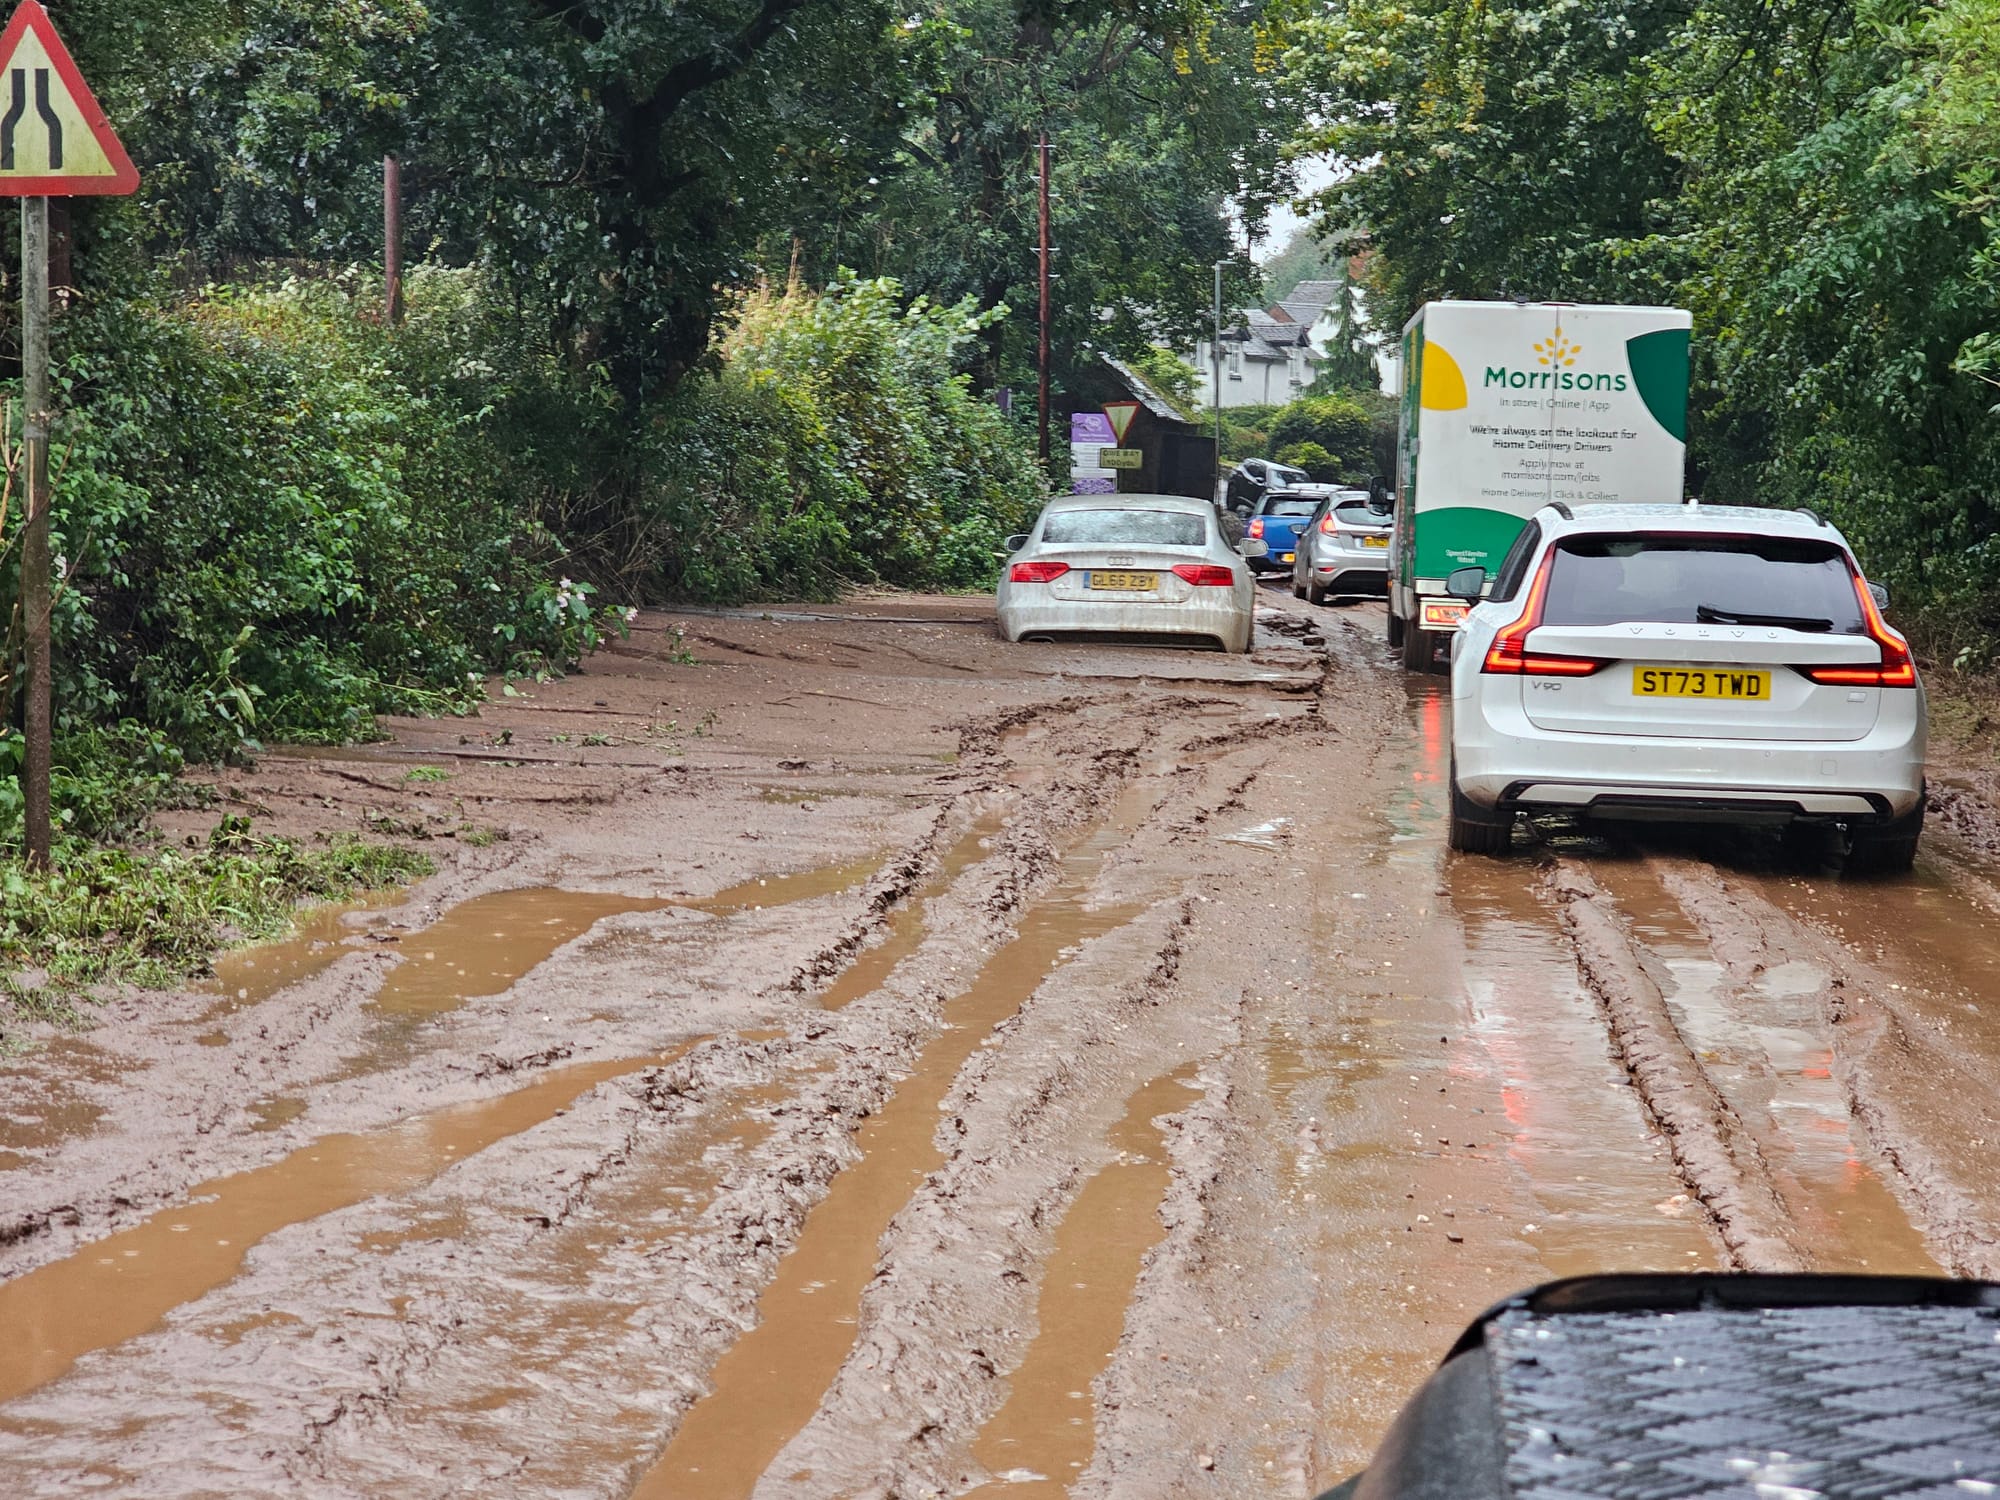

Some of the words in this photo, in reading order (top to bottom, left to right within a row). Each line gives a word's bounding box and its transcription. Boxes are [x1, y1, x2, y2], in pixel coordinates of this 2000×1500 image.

[1484, 364, 1627, 391] Morrisons
[1512, 399, 1537, 408] store
[1546, 398, 1580, 409] Online
[1589, 401, 1610, 412] App
[1501, 426, 1537, 438] always
[1539, 429, 1552, 437] on
[1555, 427, 1573, 437] the
[1576, 427, 1618, 439] lookout
[1621, 429, 1637, 439] for
[1493, 439, 1525, 449] Home
[1527, 440, 1571, 453] Delivery
[1574, 441, 1613, 452] Drivers
[1519, 459, 1546, 470] Apply
[1481, 488, 1509, 497] Home
[1511, 489, 1546, 499] Delivery
[1555, 489, 1575, 499] Click
[1587, 491, 1619, 501] Collect
[1093, 574, 1127, 586] GL66
[1532, 680, 1562, 691] V90
[1642, 671, 1706, 694] ST73
[1714, 673, 1760, 696] TWD
